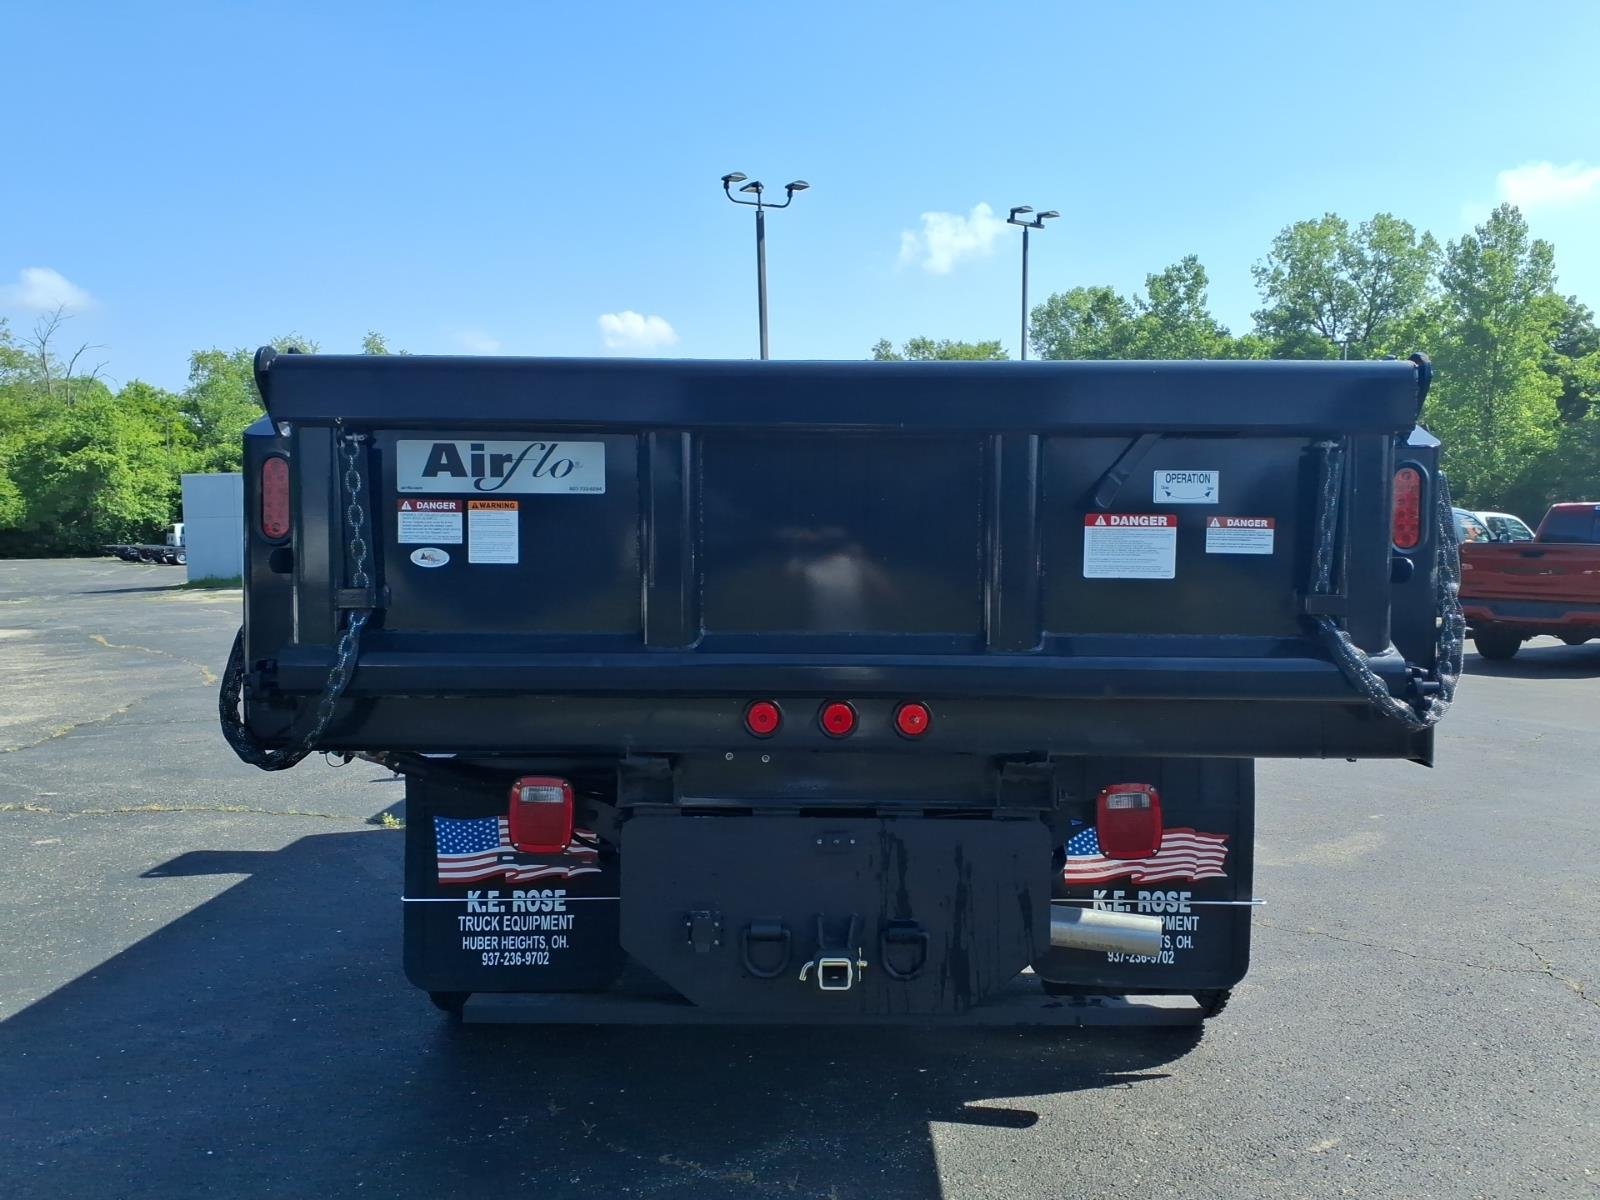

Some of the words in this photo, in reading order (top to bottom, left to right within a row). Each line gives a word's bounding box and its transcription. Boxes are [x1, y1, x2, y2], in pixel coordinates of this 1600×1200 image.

[421, 442, 576, 491] Airflo
[1165, 473, 1211, 484] OPERATION
[416, 501, 456, 510] DANGER
[1110, 515, 1168, 526] DANGER
[1226, 519, 1268, 527] DANGER
[467, 890, 505, 913] K.E.
[512, 889, 567, 913] ROSE
[1093, 889, 1131, 912] K.E.
[1137, 890, 1192, 913] ROSE
[457, 915, 500, 931] TRUCK
[503, 914, 575, 931] EQUIPMENT
[462, 936, 499, 950] HUBER
[501, 935, 549, 952] HEIGHTS,
[551, 935, 570, 949] OH.
[1176, 935, 1194, 949] OH.
[481, 951, 550, 966] 937-236-9702
